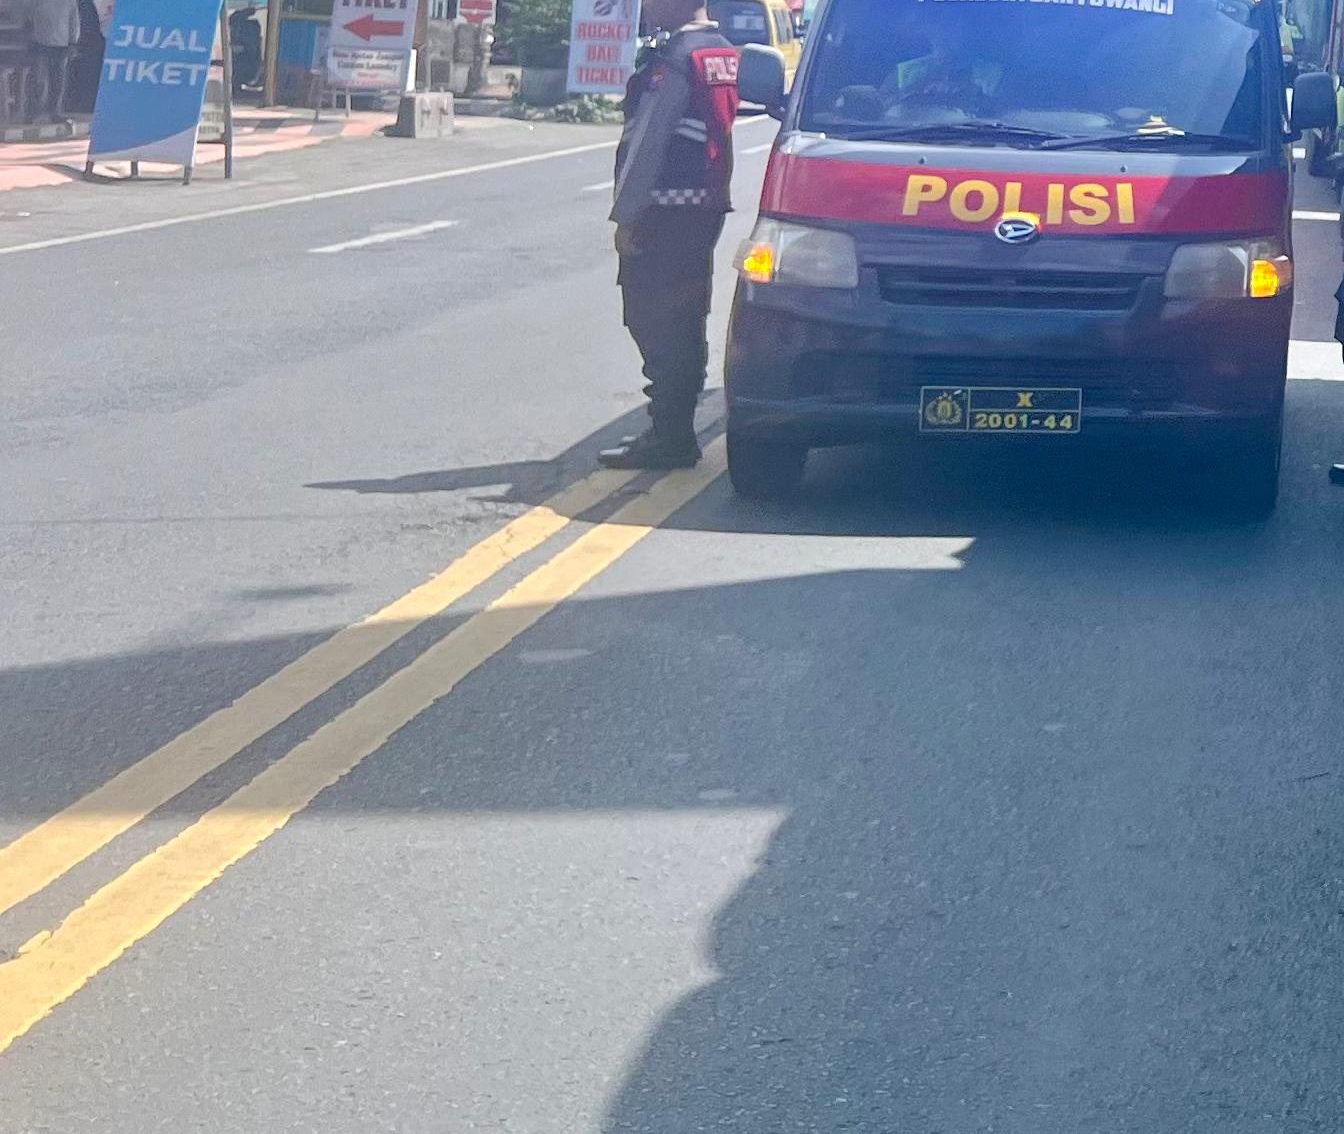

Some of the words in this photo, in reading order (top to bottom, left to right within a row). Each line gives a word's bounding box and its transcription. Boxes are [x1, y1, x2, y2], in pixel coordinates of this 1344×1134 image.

[114, 25, 206, 53] JUAL
[103, 58, 208, 86] TIKET
[902, 174, 1135, 226] POLISI
[1017, 392, 1033, 407] X
[975, 413, 1072, 429] 2001-44
